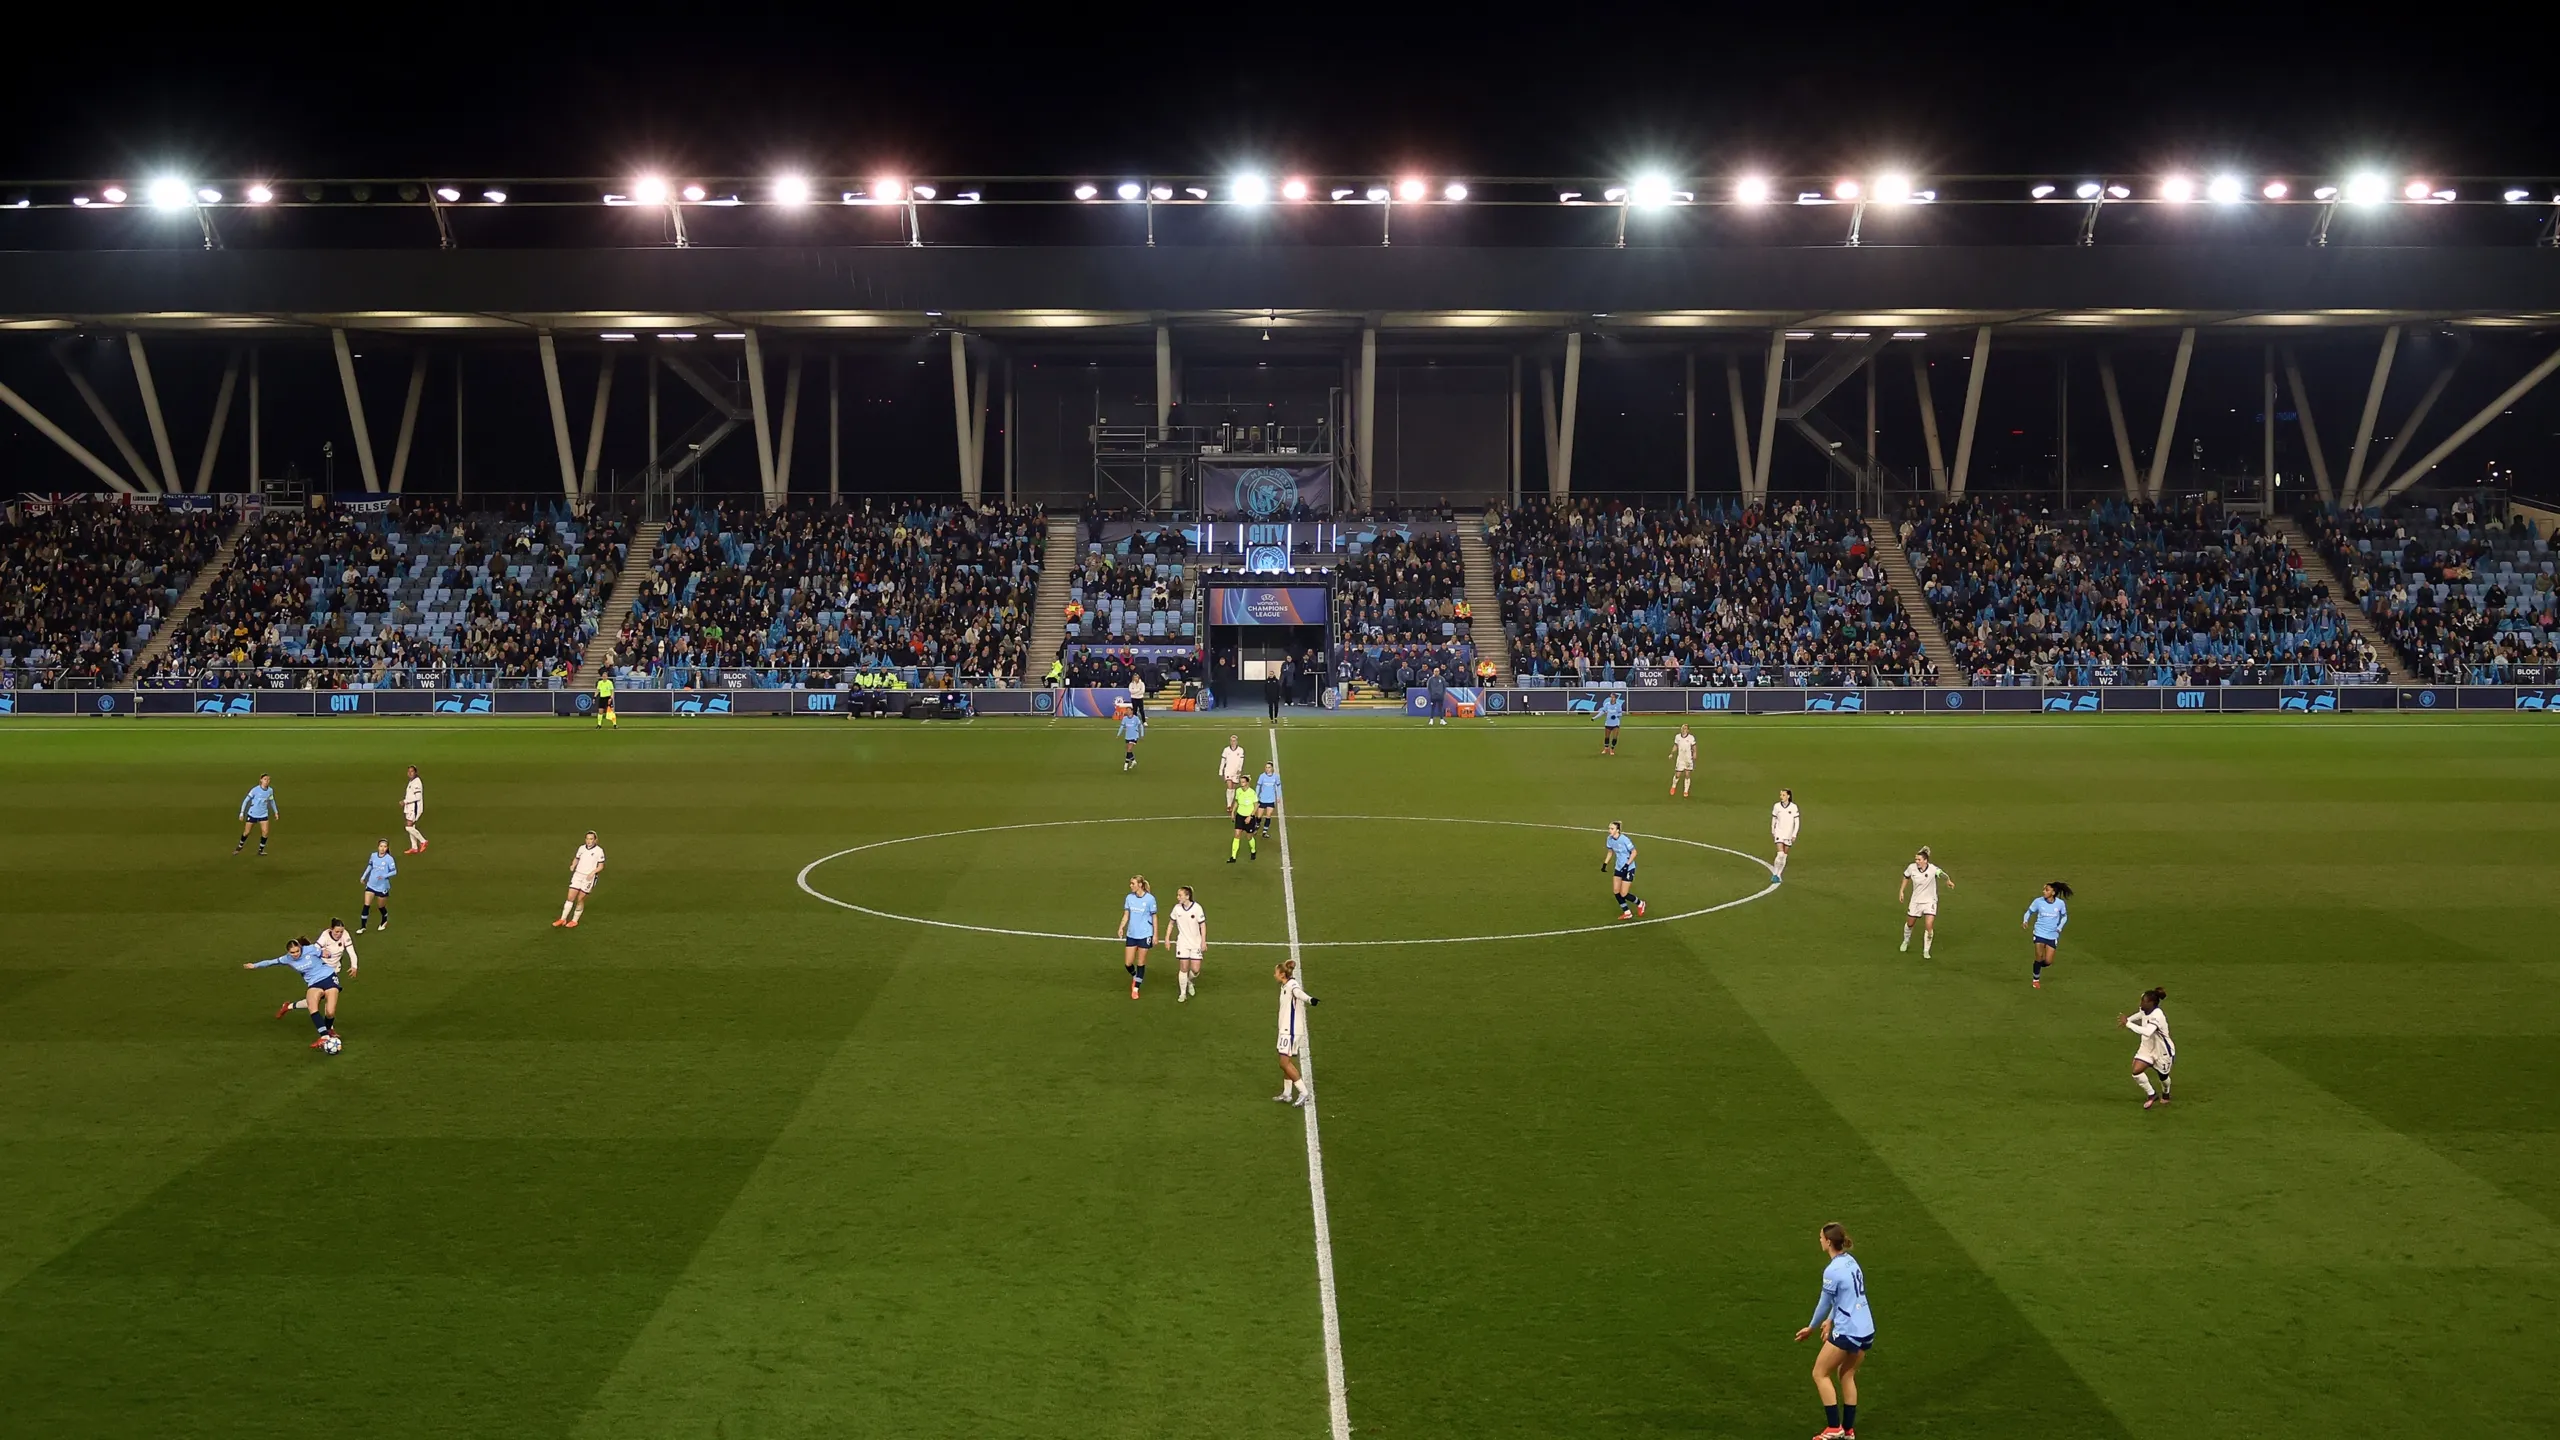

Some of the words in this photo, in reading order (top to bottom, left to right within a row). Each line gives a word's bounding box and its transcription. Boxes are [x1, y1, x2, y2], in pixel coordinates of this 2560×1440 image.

[1250, 469, 1293, 500] MANCHESTER
[348, 502, 387, 512] HELSE
[1249, 524, 1285, 544] CITY
[270, 680, 285, 688] W6
[420, 680, 435, 688] W6
[728, 680, 742, 688] W5
[1643, 678, 1658, 687] W3
[2099, 677, 2114, 685] W2
[330, 694, 359, 712] CITY
[807, 694, 837, 711] CITY
[1702, 692, 1731, 710] CITY
[2176, 691, 2205, 708] CITY
